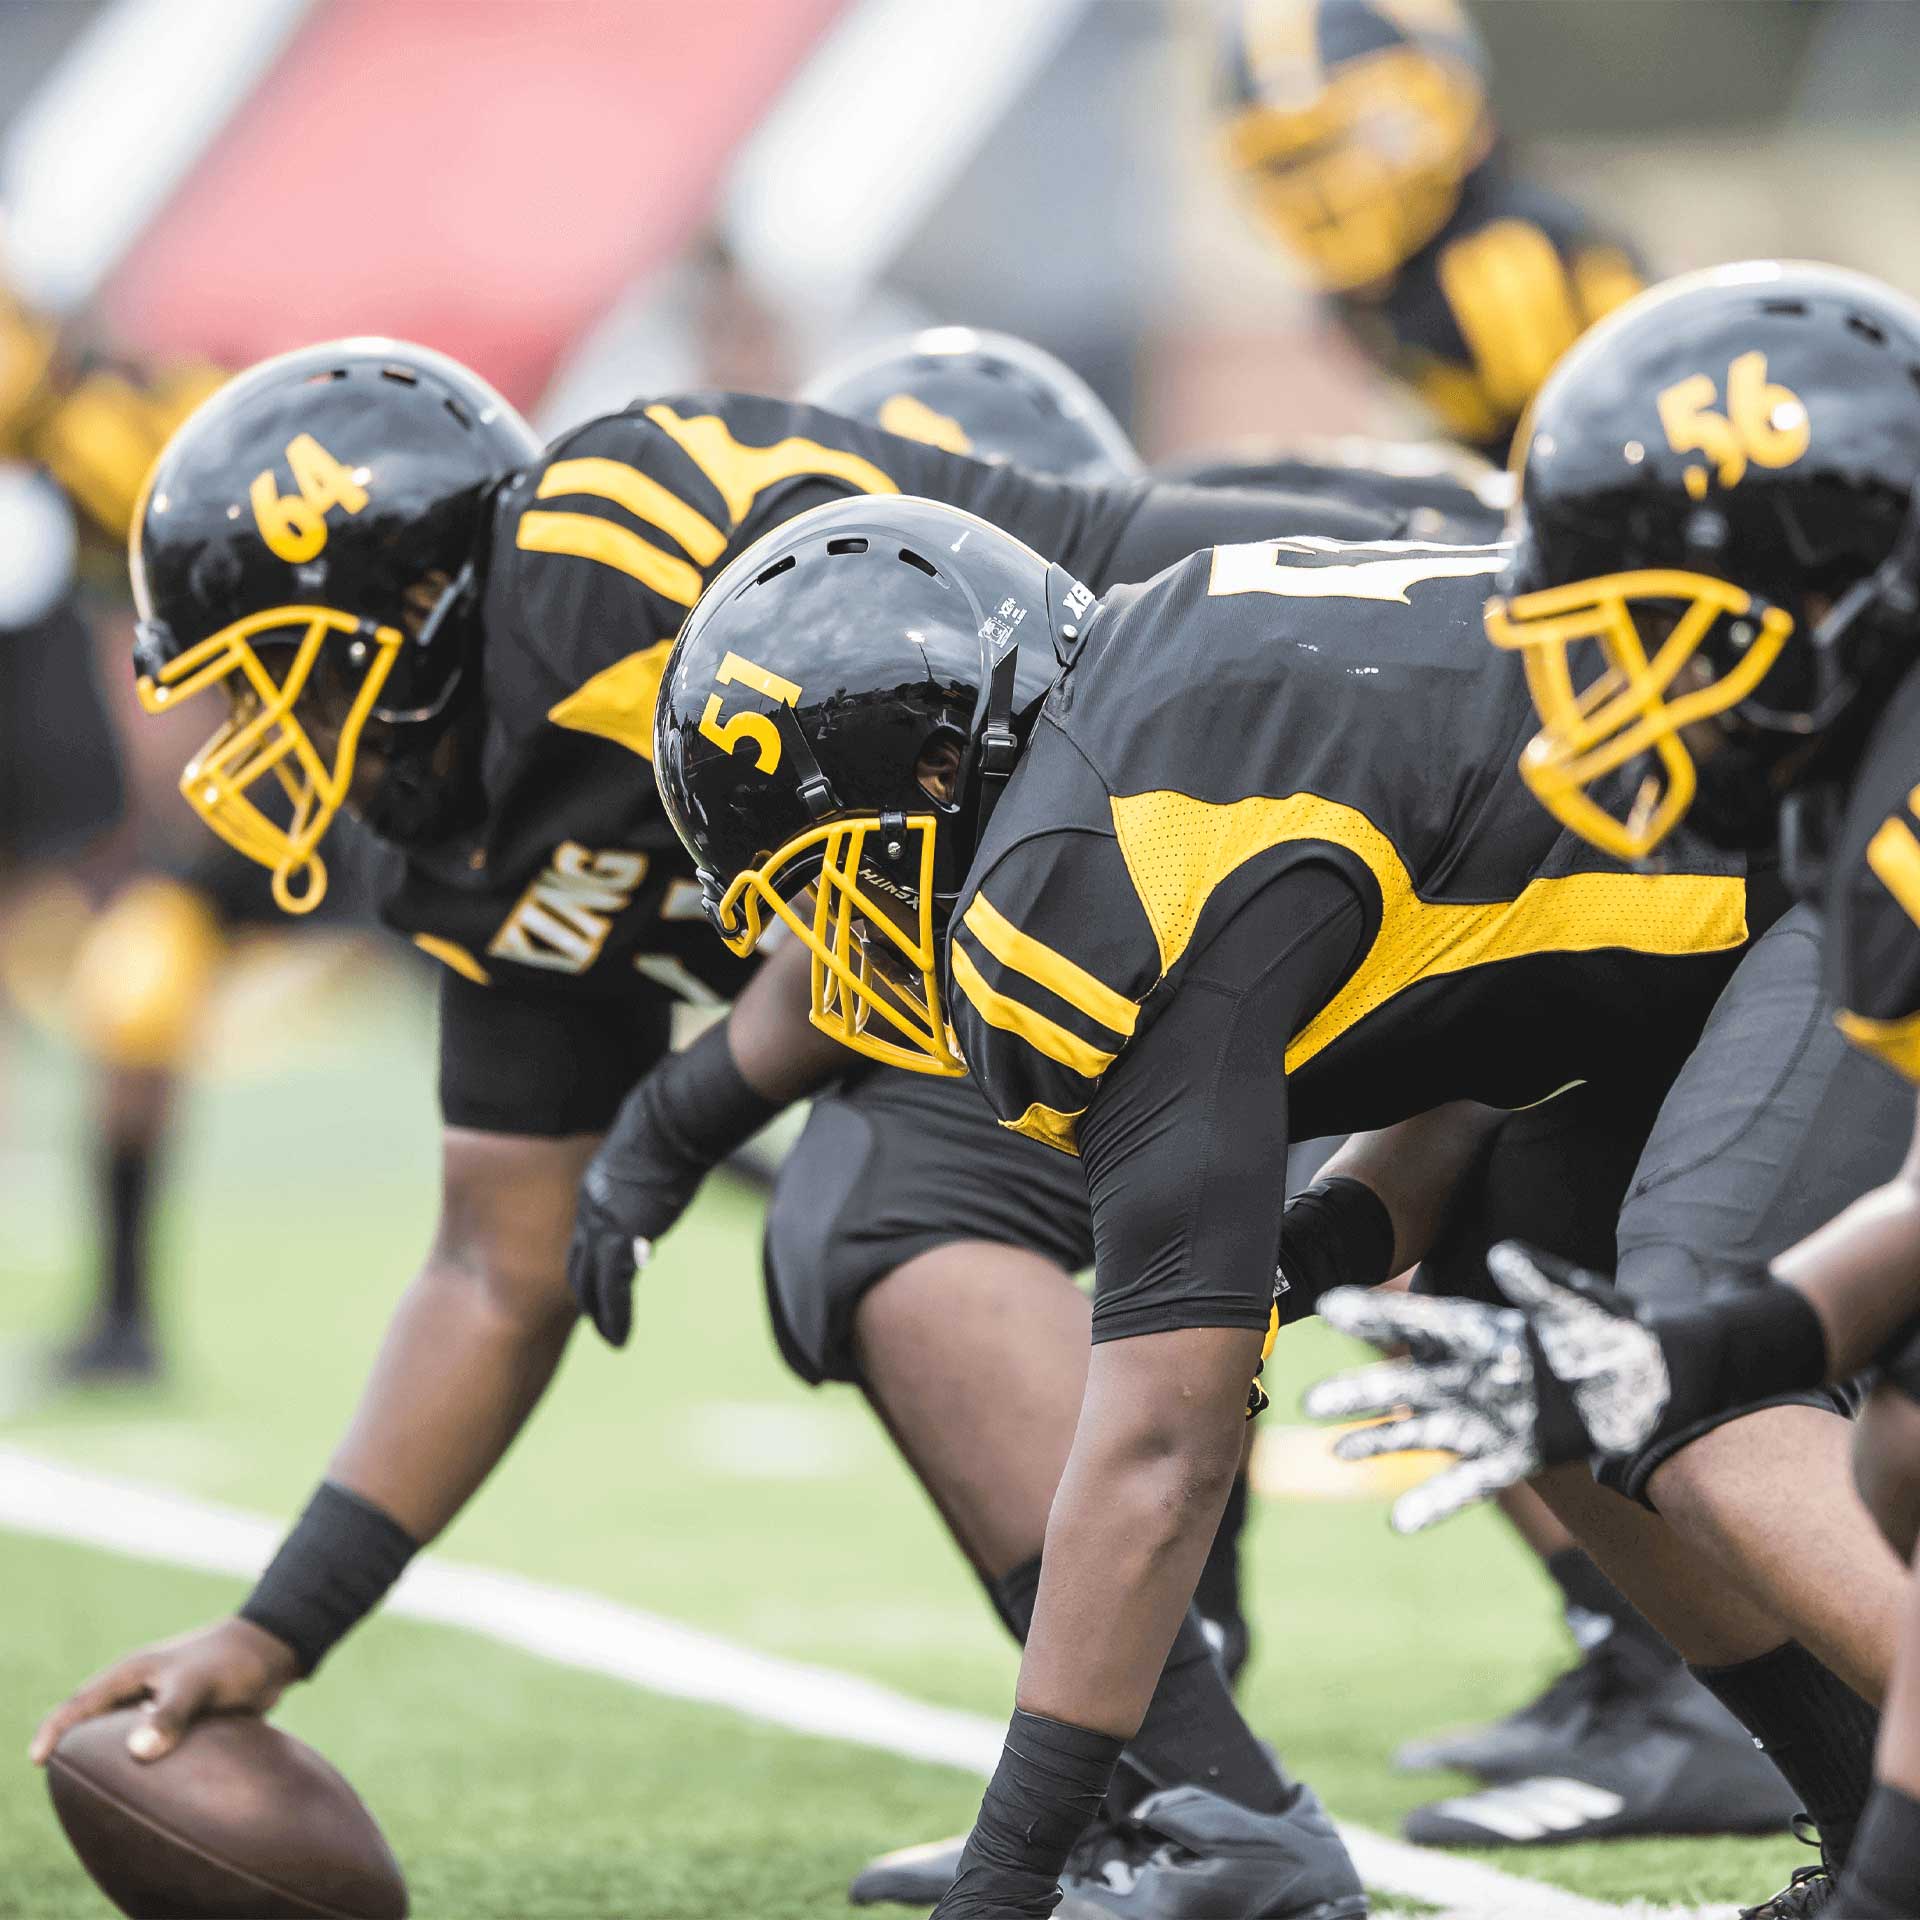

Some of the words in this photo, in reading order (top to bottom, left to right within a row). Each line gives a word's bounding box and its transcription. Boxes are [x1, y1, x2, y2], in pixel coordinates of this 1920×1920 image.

[1657, 349, 1811, 503] 56
[249, 432, 371, 564] 64
[698, 650, 803, 776] 51
[858, 868, 920, 911] XENITH
